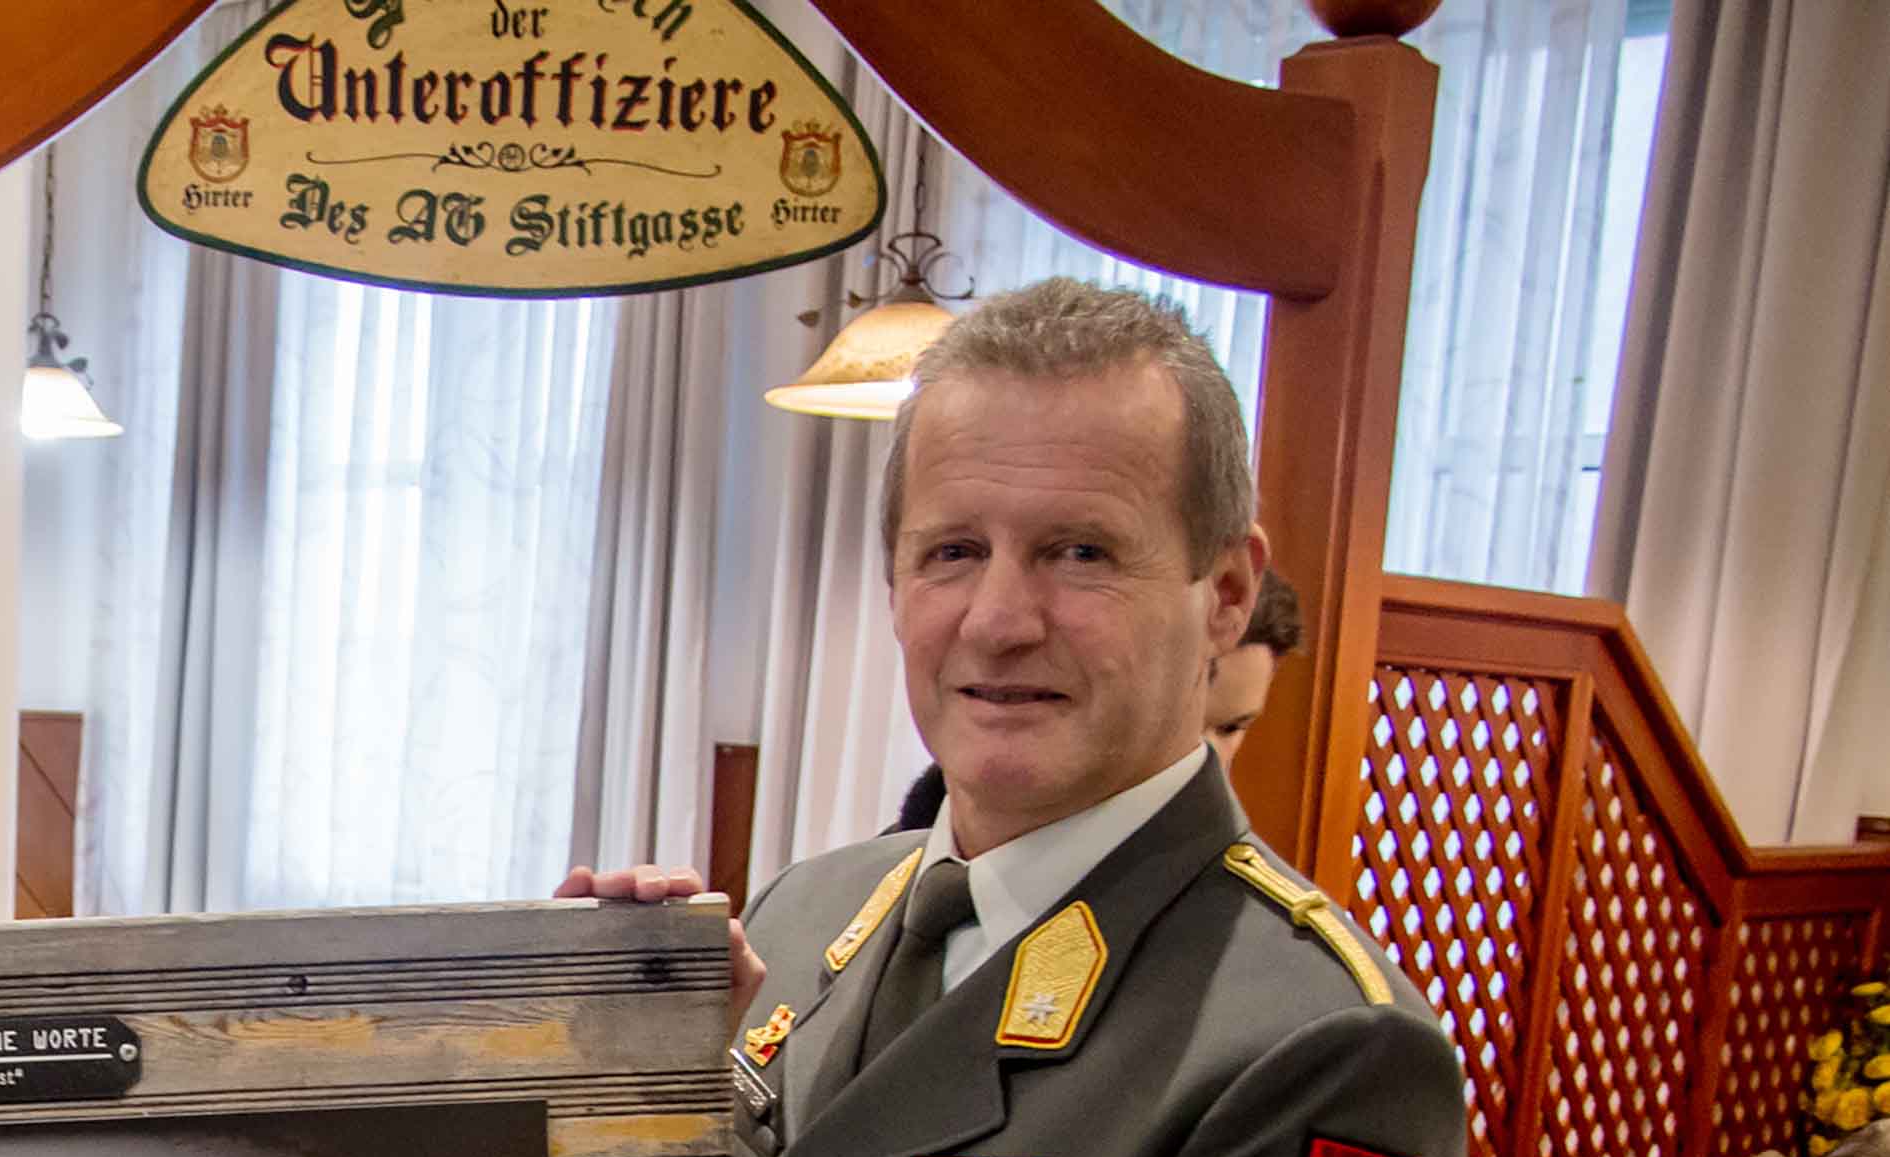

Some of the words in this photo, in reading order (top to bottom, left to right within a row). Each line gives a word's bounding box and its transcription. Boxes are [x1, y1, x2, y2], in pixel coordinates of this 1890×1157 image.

[491, 0, 549, 38] der
[265, 31, 779, 136] Unteroffiziere
[182, 183, 253, 215] Hirter
[279, 173, 370, 245] Des
[505, 192, 746, 258] Stiftgasse
[770, 198, 842, 230] Hirter
[32, 1027, 108, 1049] WORTE
